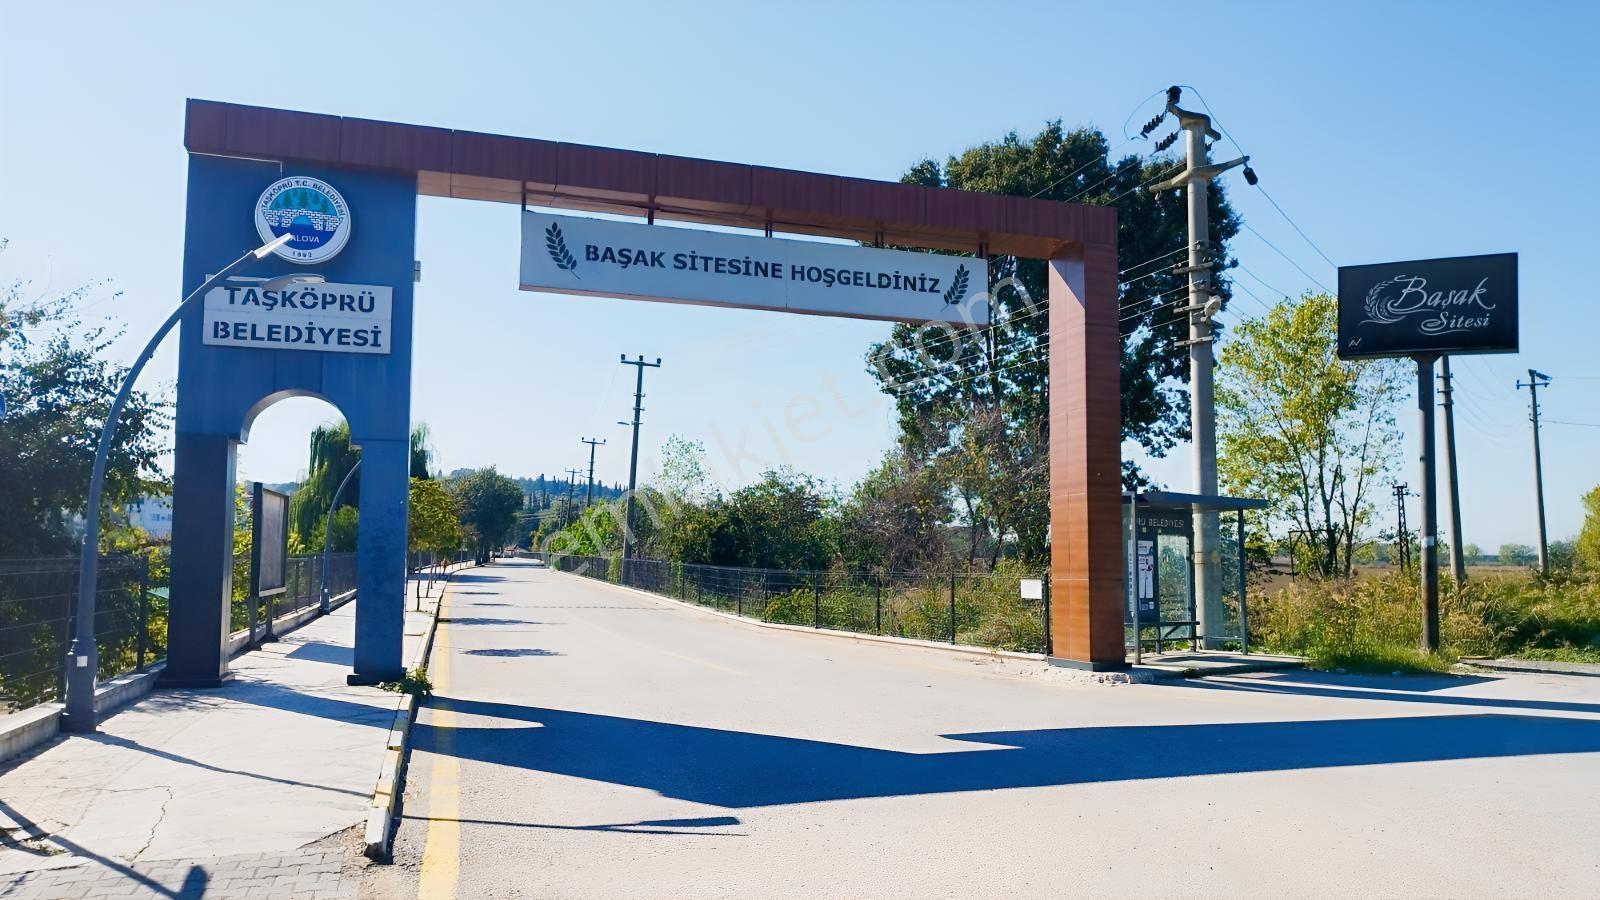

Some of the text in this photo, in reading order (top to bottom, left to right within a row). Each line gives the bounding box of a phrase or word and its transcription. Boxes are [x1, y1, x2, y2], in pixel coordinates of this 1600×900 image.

[286, 234, 320, 243] ALOVA
[585, 243, 941, 294] BAŞAK SİTESİNE HOŞGELDİNİZ
[224, 286, 376, 314] TAŞKÖPRÜ
[213, 321, 382, 348] BELEDİYESİ
[1420, 312, 1491, 335] Sitesi
